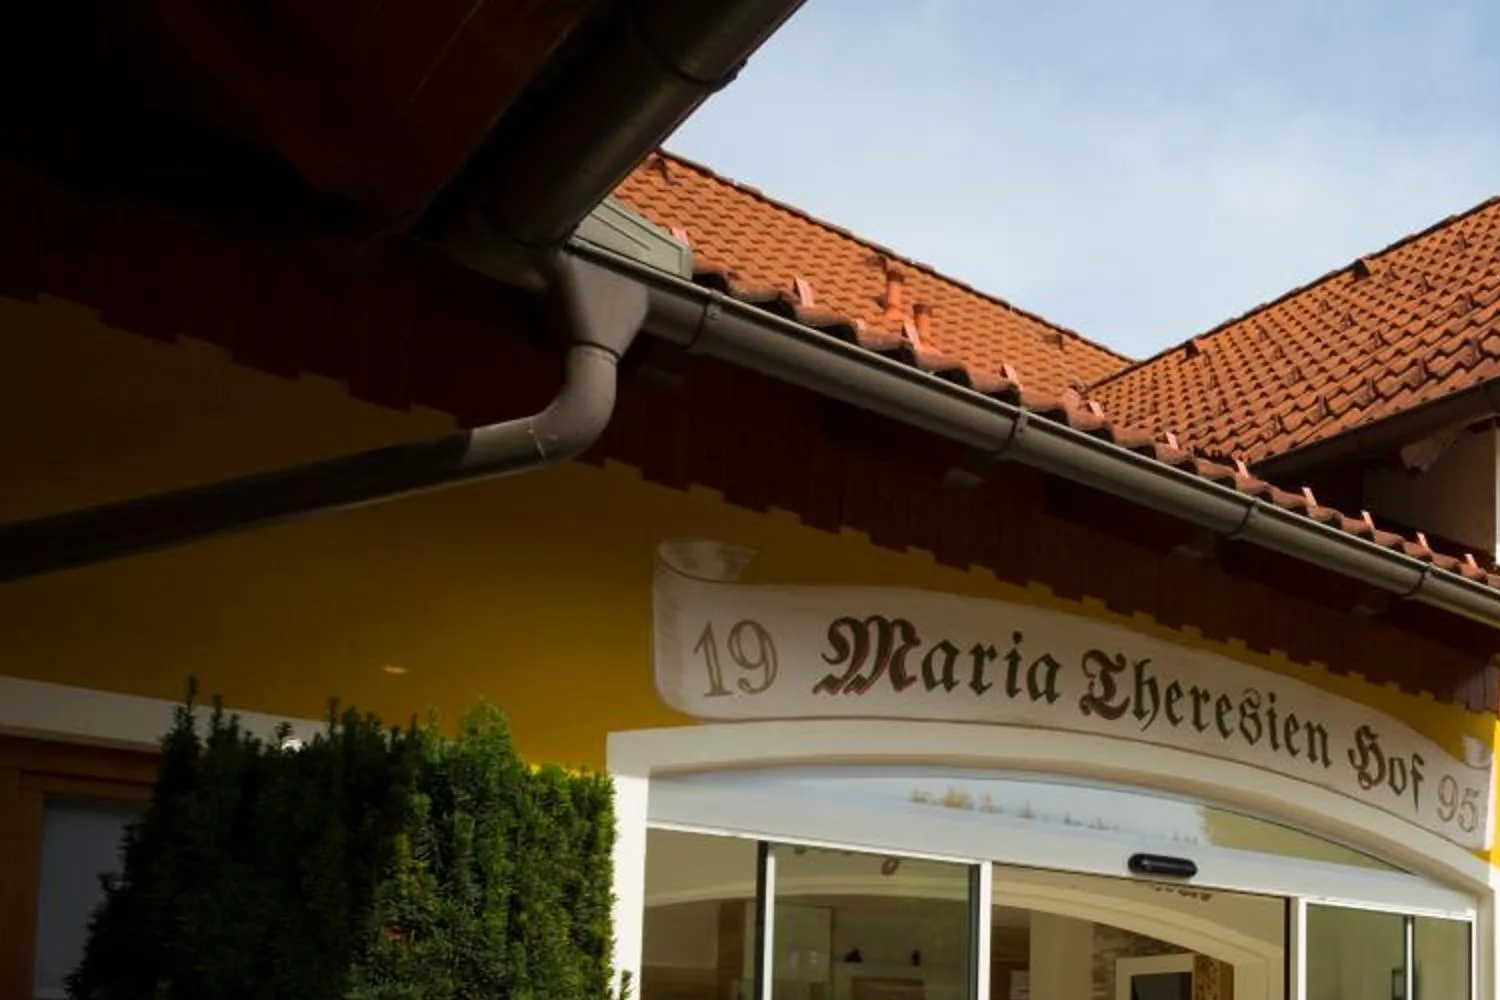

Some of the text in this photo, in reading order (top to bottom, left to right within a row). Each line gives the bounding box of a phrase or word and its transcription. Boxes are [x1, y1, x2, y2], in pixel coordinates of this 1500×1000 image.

[693, 615, 1480, 833] 19 Maria Theresien Hof 95
